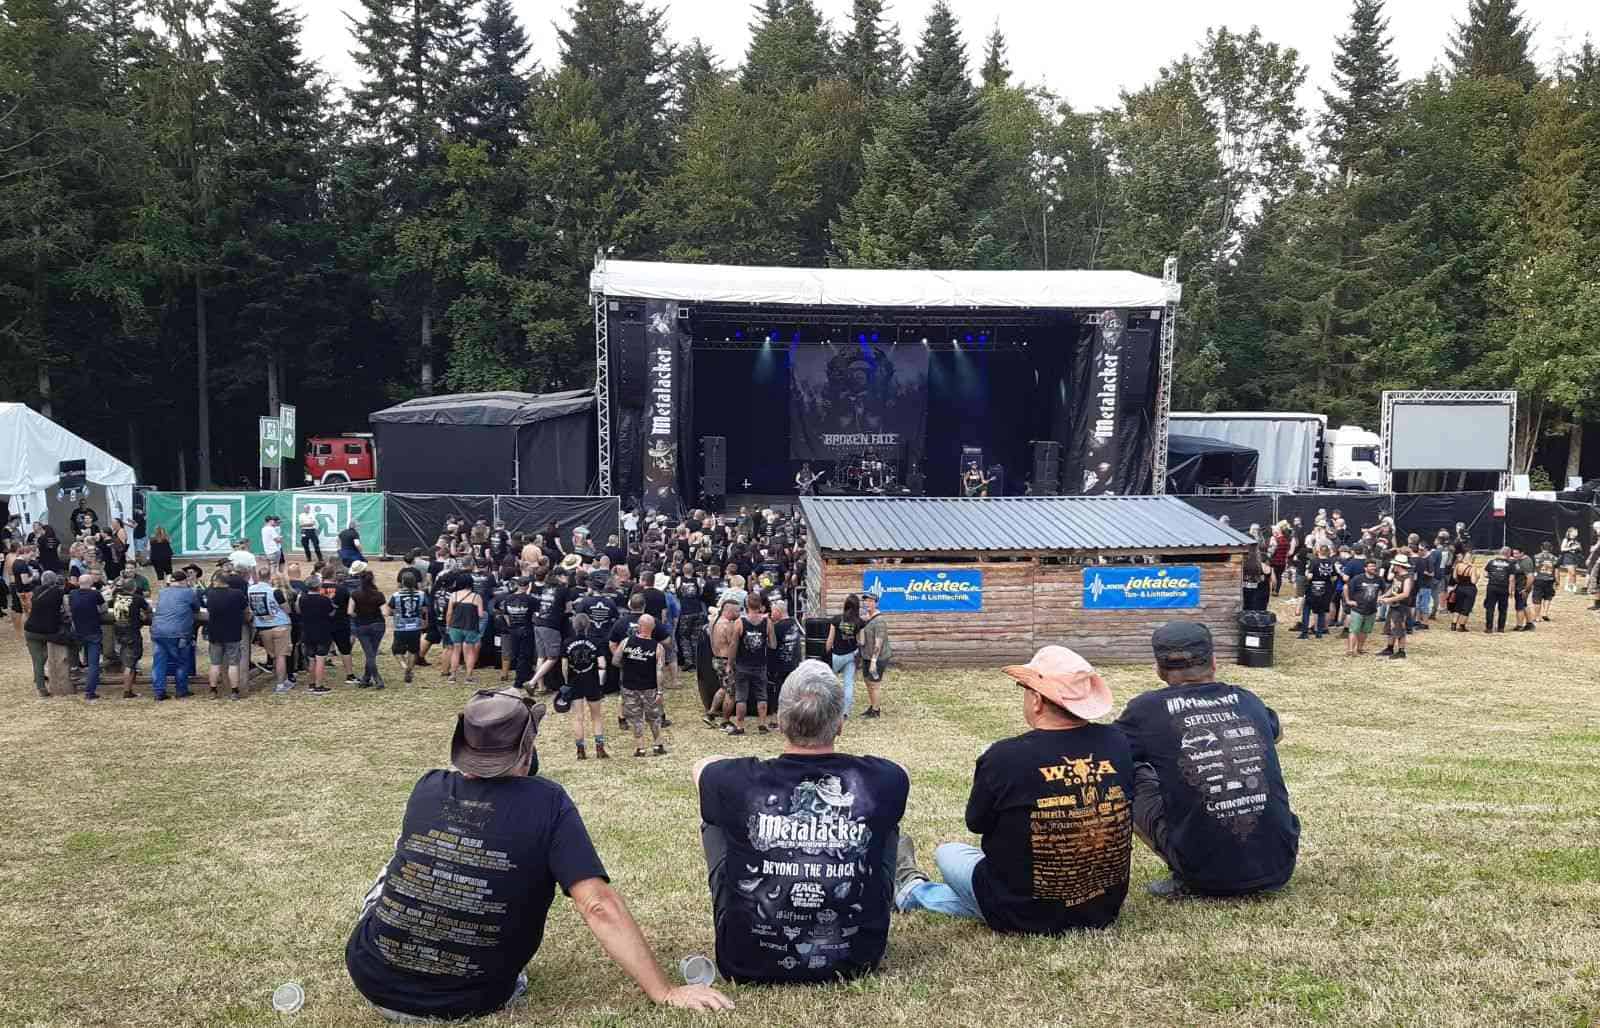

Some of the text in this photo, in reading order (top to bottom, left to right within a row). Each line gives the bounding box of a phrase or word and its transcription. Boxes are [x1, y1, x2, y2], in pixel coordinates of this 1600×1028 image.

[651, 347, 672, 434] Metalacker
[1095, 353, 1119, 437] Metalacker
[823, 433, 898, 446] BROKEN FATE
[1183, 711, 1240, 727] SEPULTURA
[758, 811, 866, 841] Metalacker
[763, 860, 856, 878] BEYOND THE BLACK
[790, 882, 825, 896] RAGE
